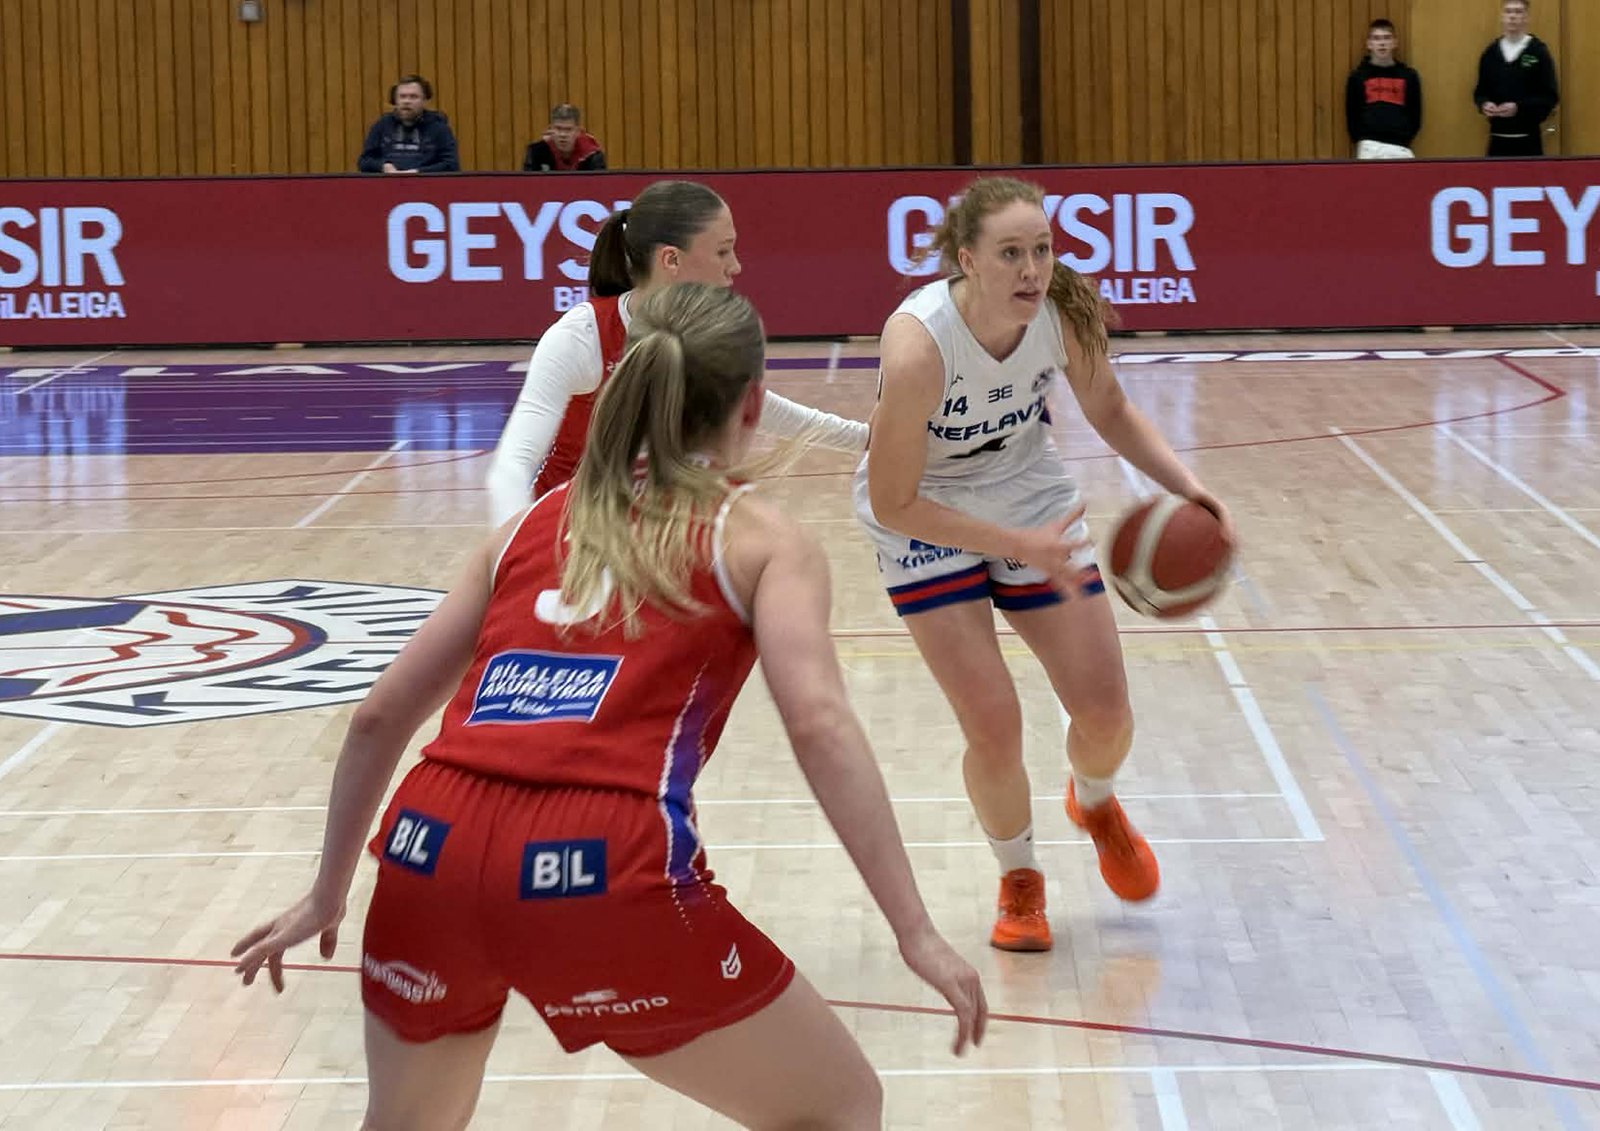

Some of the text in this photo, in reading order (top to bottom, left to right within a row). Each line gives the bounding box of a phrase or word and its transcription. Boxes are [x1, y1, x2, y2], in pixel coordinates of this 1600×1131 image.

[386, 199, 634, 283] GEYS
[887, 192, 1198, 277] GSIR
[943, 395, 969, 417] 14
